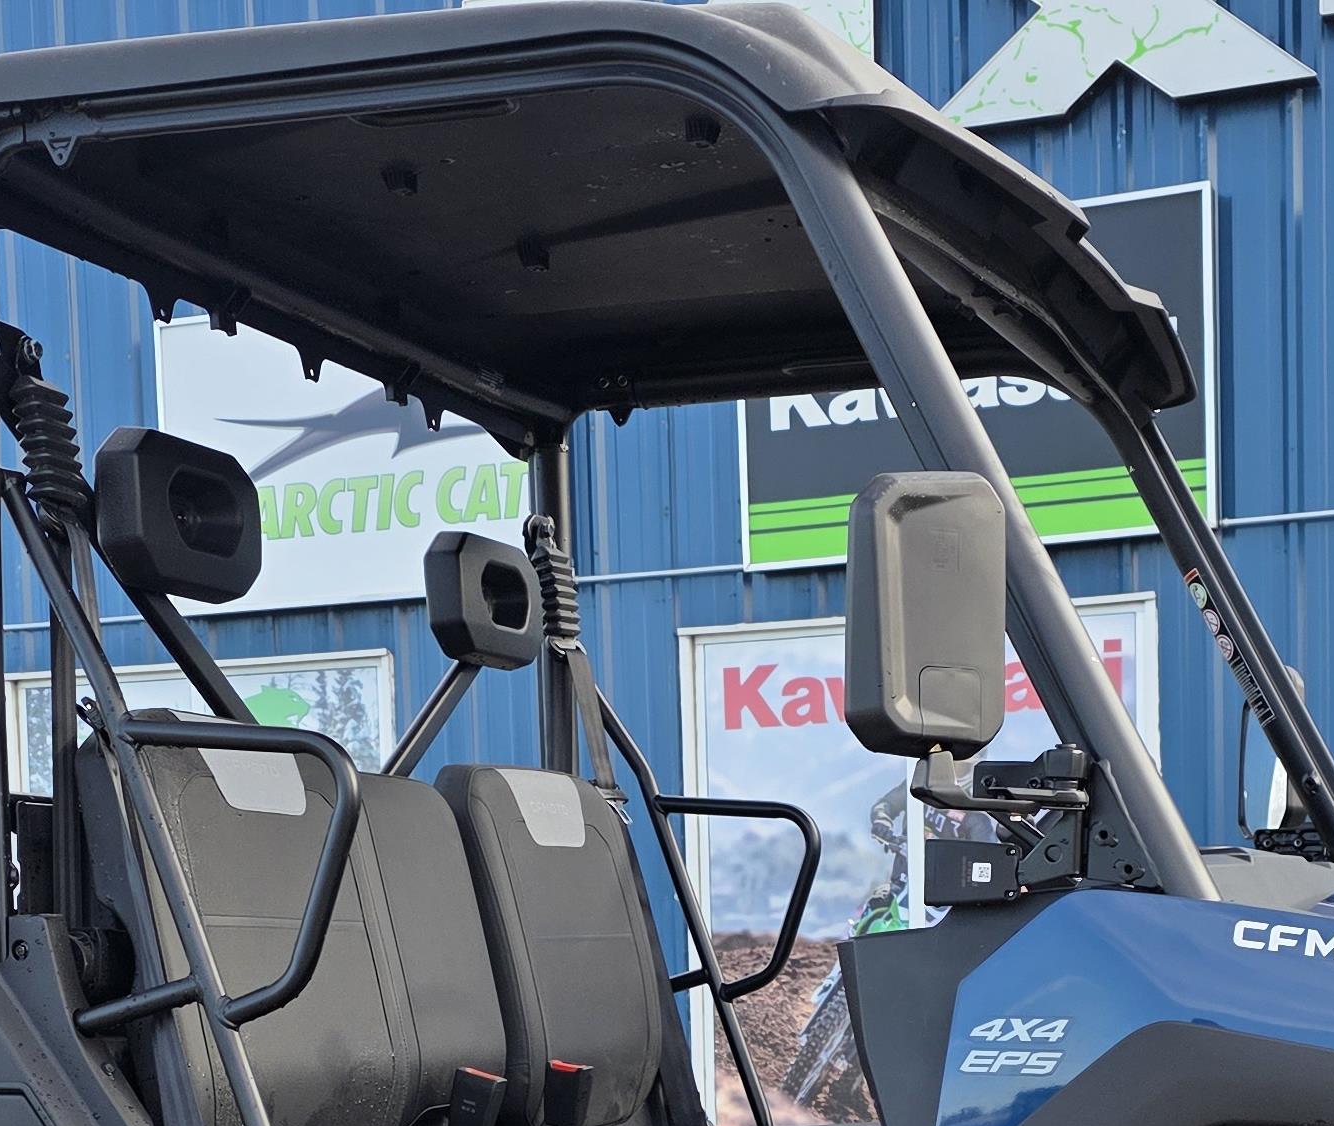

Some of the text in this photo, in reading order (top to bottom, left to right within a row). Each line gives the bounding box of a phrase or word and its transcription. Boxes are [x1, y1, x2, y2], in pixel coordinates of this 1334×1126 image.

[256, 470, 424, 540] ARCTIC
[435, 461, 529, 524] CAT
[970, 1018, 1069, 1042] 4X4
[959, 1050, 1063, 1075] EPS
